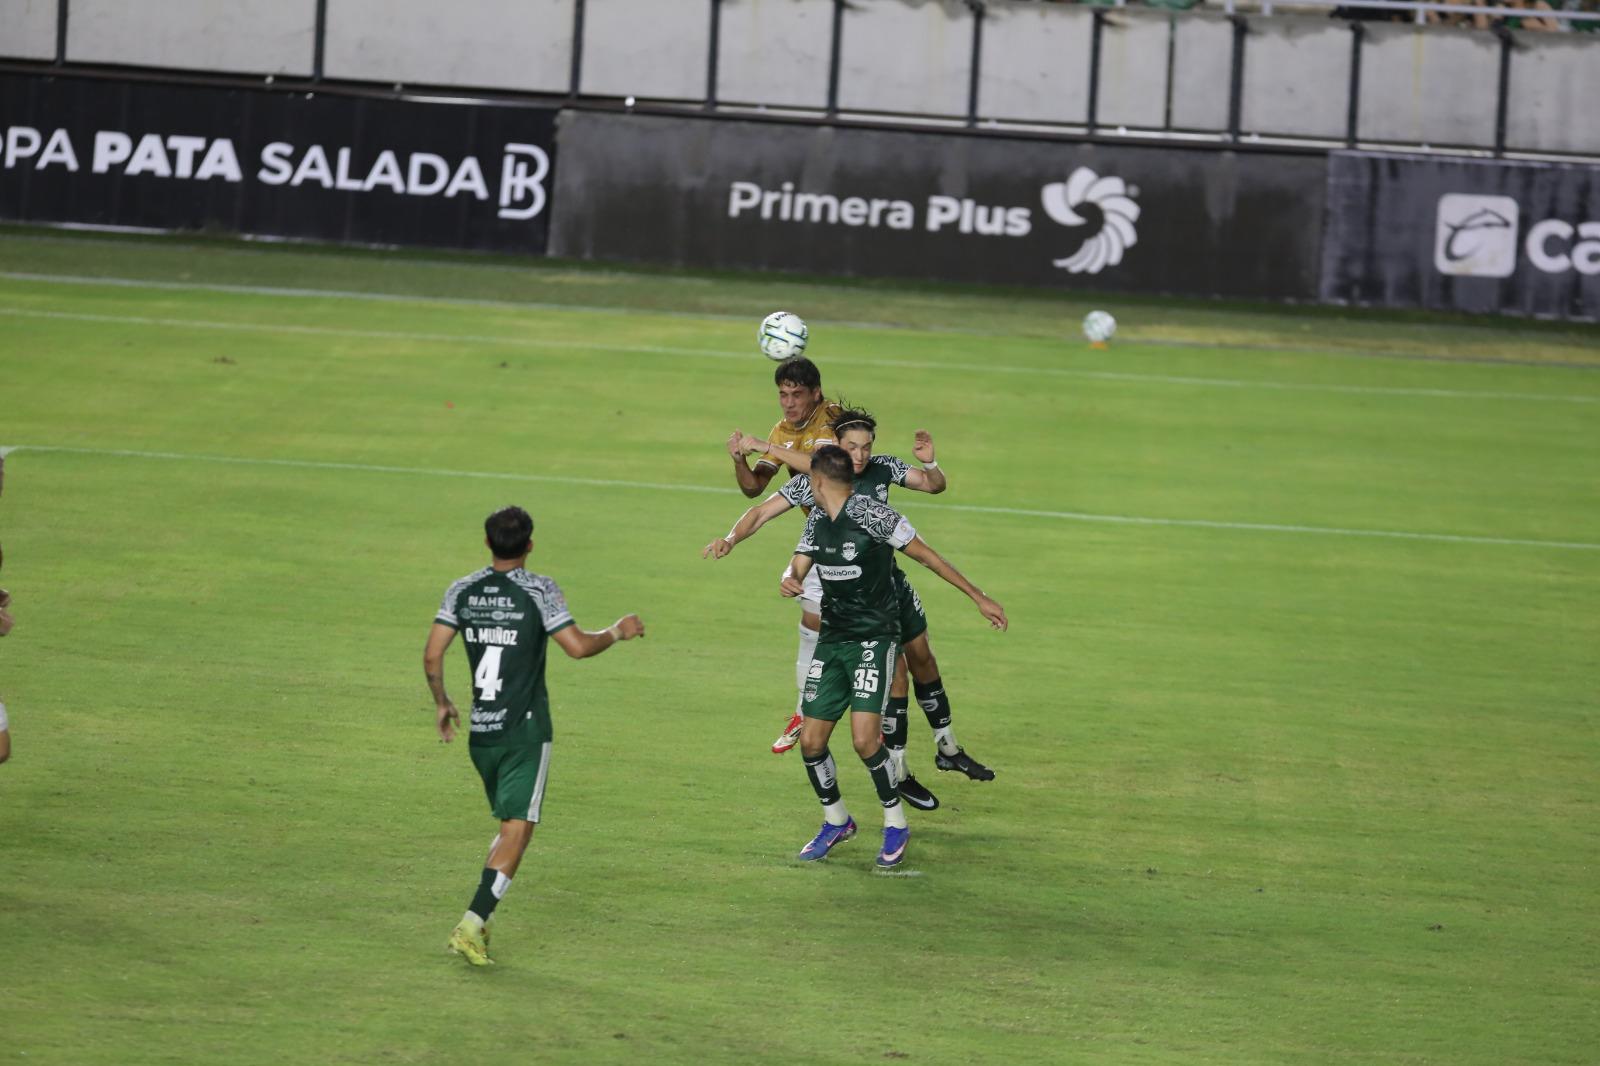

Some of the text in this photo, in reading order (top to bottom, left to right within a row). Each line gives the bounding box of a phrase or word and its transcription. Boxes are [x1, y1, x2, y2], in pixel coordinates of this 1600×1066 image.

[0, 126, 489, 200] PA PATA SALADA
[728, 182, 1032, 236] Primera Plus
[468, 596, 515, 608] NAHEL
[478, 626, 518, 645] MUÑOZ
[475, 645, 504, 701] 4
[853, 669, 879, 692] 35
